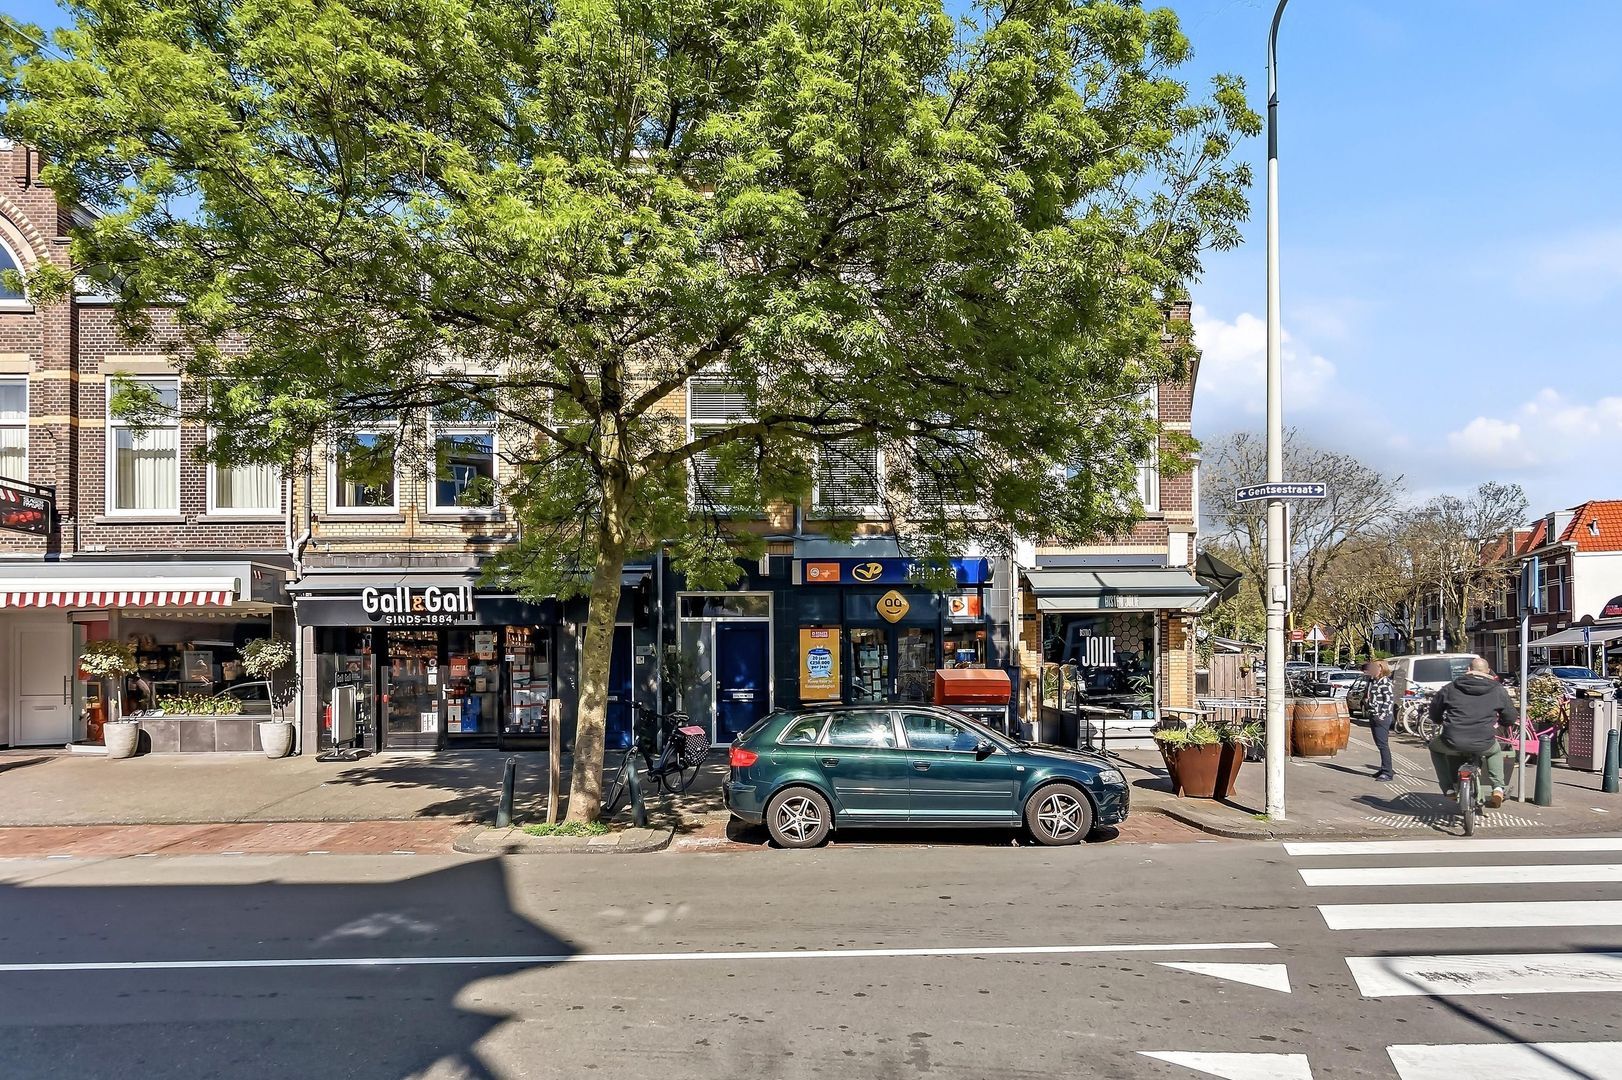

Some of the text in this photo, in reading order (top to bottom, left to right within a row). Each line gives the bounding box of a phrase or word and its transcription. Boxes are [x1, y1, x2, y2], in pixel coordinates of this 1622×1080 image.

[1248, 485, 1312, 496] Gentsestraat
[362, 586, 411, 613] Gall
[425, 586, 473, 612] Gall
[386, 614, 453, 624] SINDS 1884
[1082, 636, 1116, 667] JOLIE
